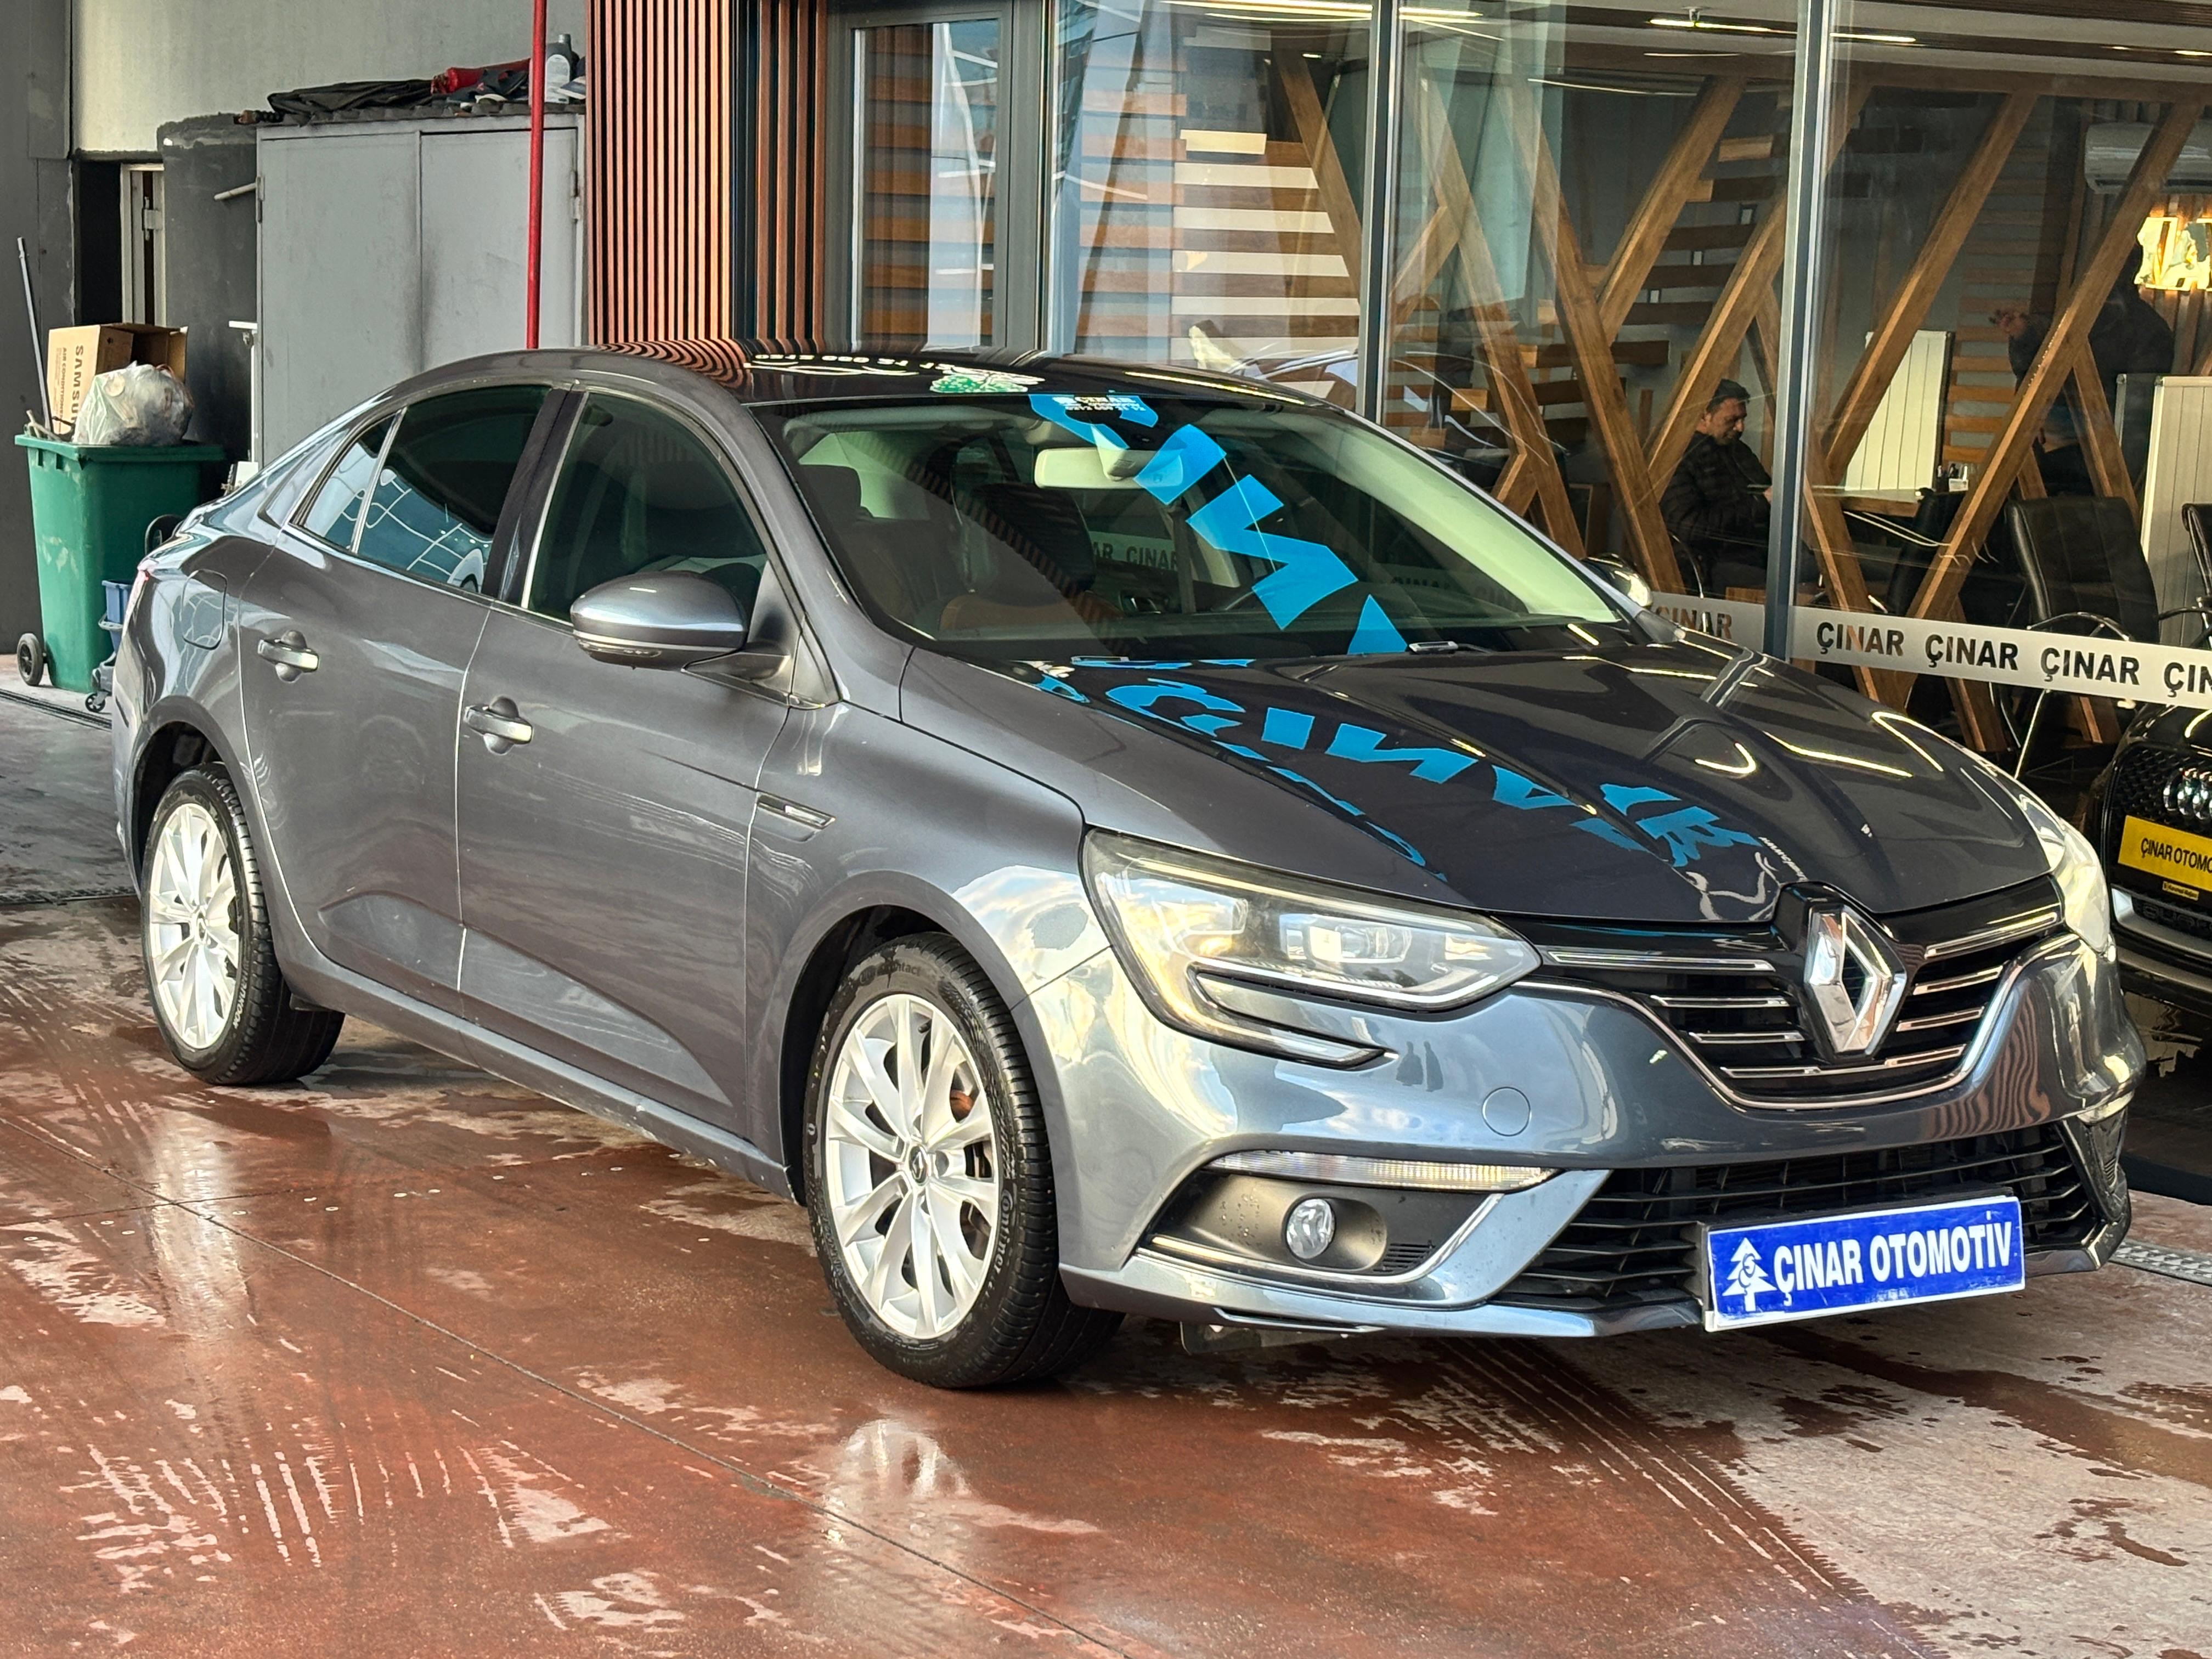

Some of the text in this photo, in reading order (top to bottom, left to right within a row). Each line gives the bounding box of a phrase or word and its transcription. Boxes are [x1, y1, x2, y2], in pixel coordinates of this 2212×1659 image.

[71, 345, 83, 421] SAMSU
[1816, 622, 1905, 657] ÇINAR
[1925, 634, 2019, 671] ÇINAR
[2040, 647, 2140, 685] ÇINAR
[2141, 837, 2173, 862] ÇINAR
[1773, 1210, 2012, 1306] ÇINAR OTOMOTİV
